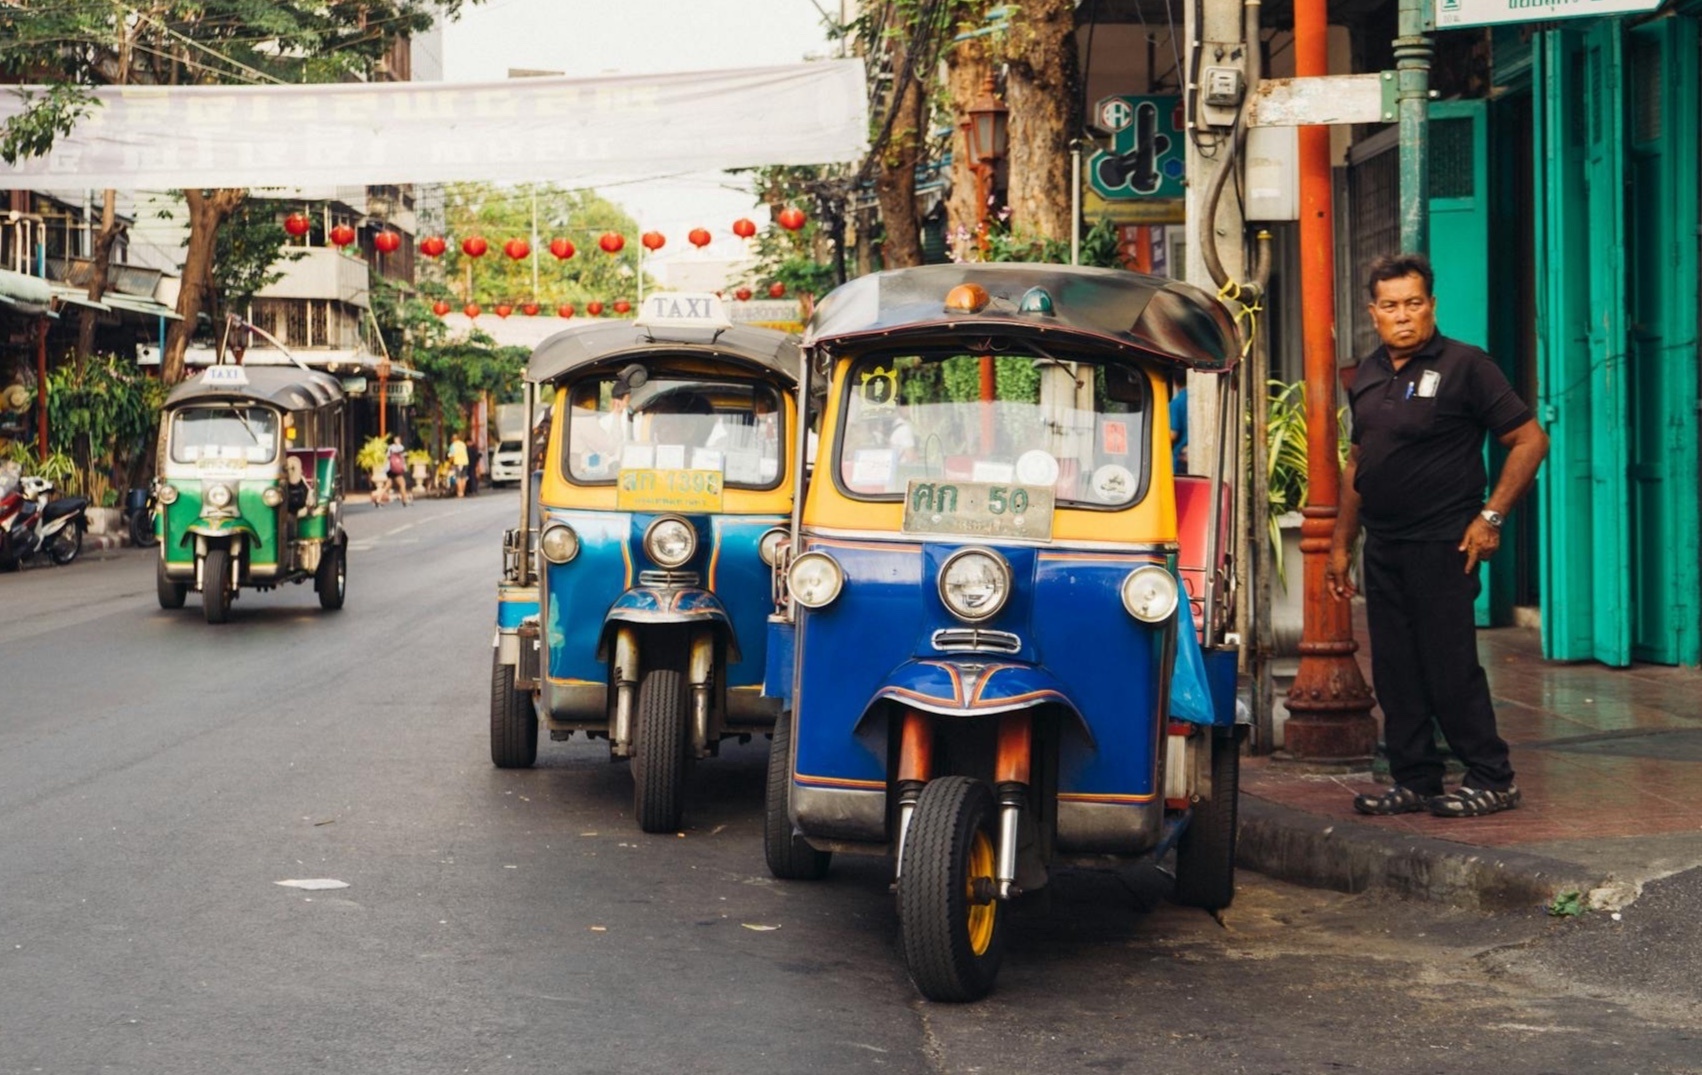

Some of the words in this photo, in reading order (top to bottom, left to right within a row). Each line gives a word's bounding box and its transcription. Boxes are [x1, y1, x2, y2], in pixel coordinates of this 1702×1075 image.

[653, 298, 712, 318] TAXI
[210, 368, 238, 379] TAXI
[988, 486, 1029, 515] 50
